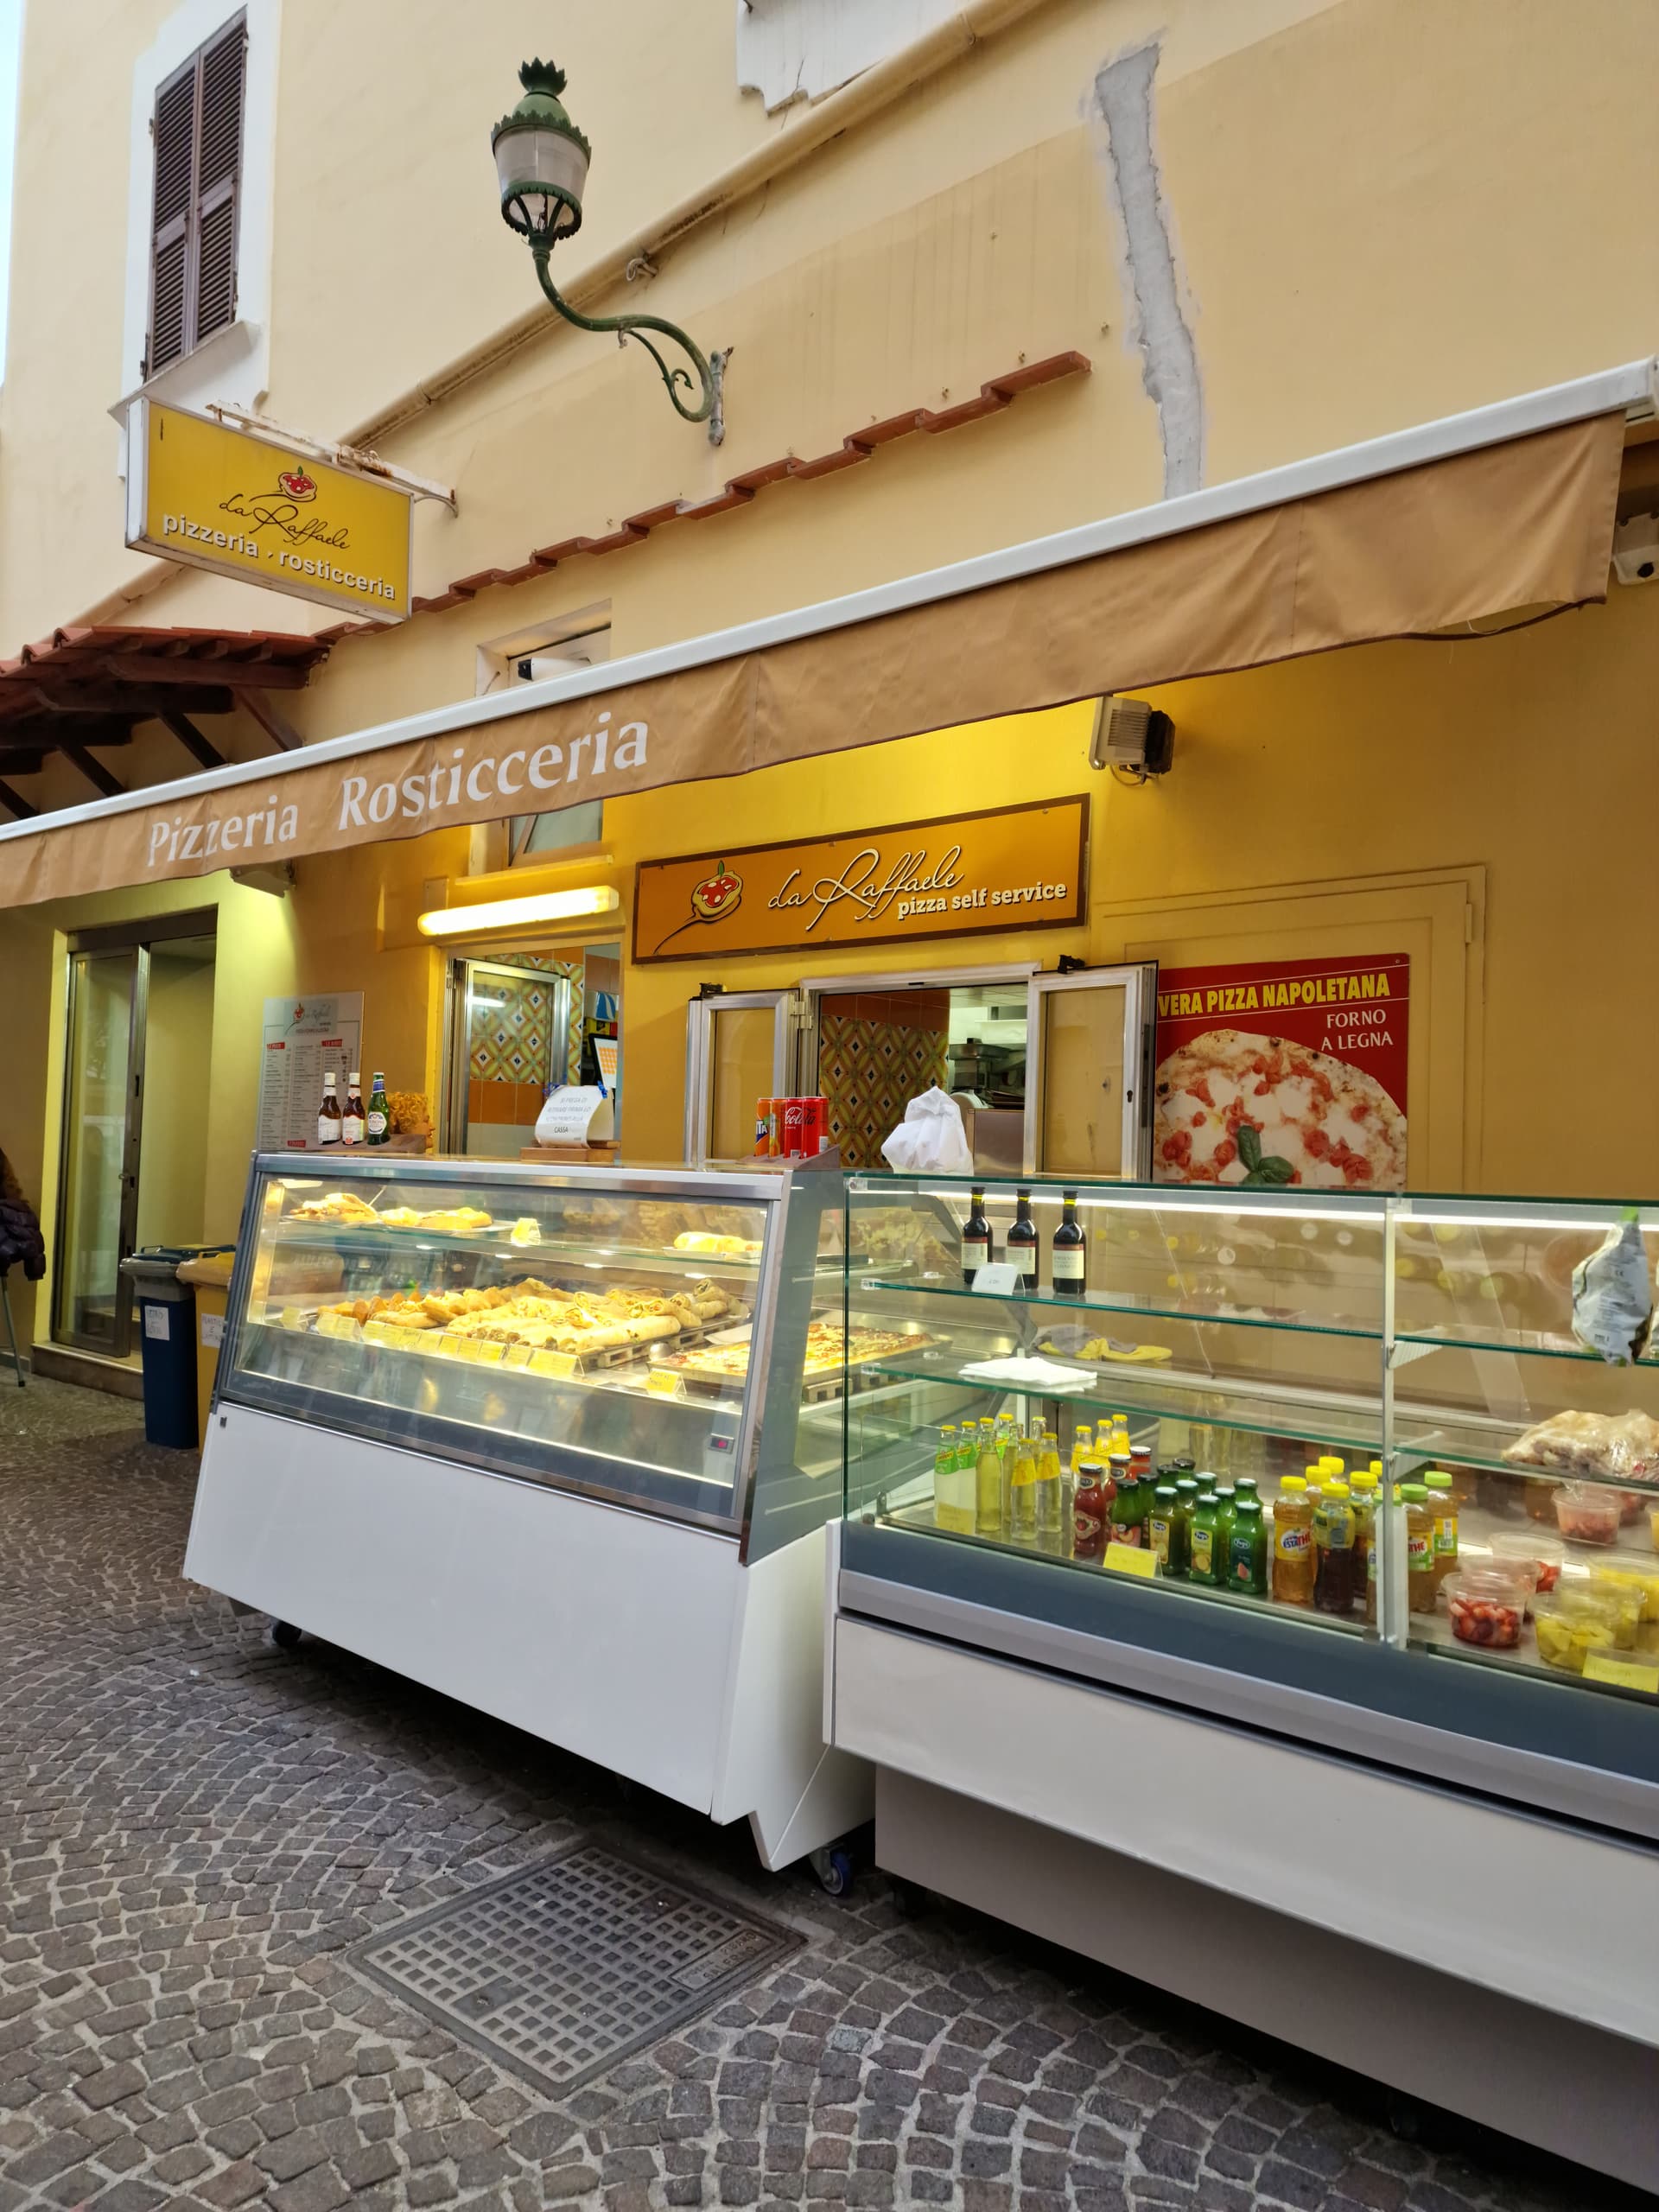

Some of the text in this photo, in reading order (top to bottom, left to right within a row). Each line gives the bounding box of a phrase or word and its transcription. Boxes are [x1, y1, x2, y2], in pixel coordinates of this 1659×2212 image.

[219, 493, 352, 550] da Raffaele
[162, 513, 396, 600] pizzeria rosticceria
[147, 711, 649, 867] Pizzeria Rosticceria
[768, 845, 964, 931] da Raffaele
[898, 881, 1067, 921] pizza self service
[1158, 973, 1390, 1017] VERA PIZZA NAPOLETANA
[1326, 1008, 1387, 1028] FORNO
[1320, 1031, 1394, 1052] A LEGNA
